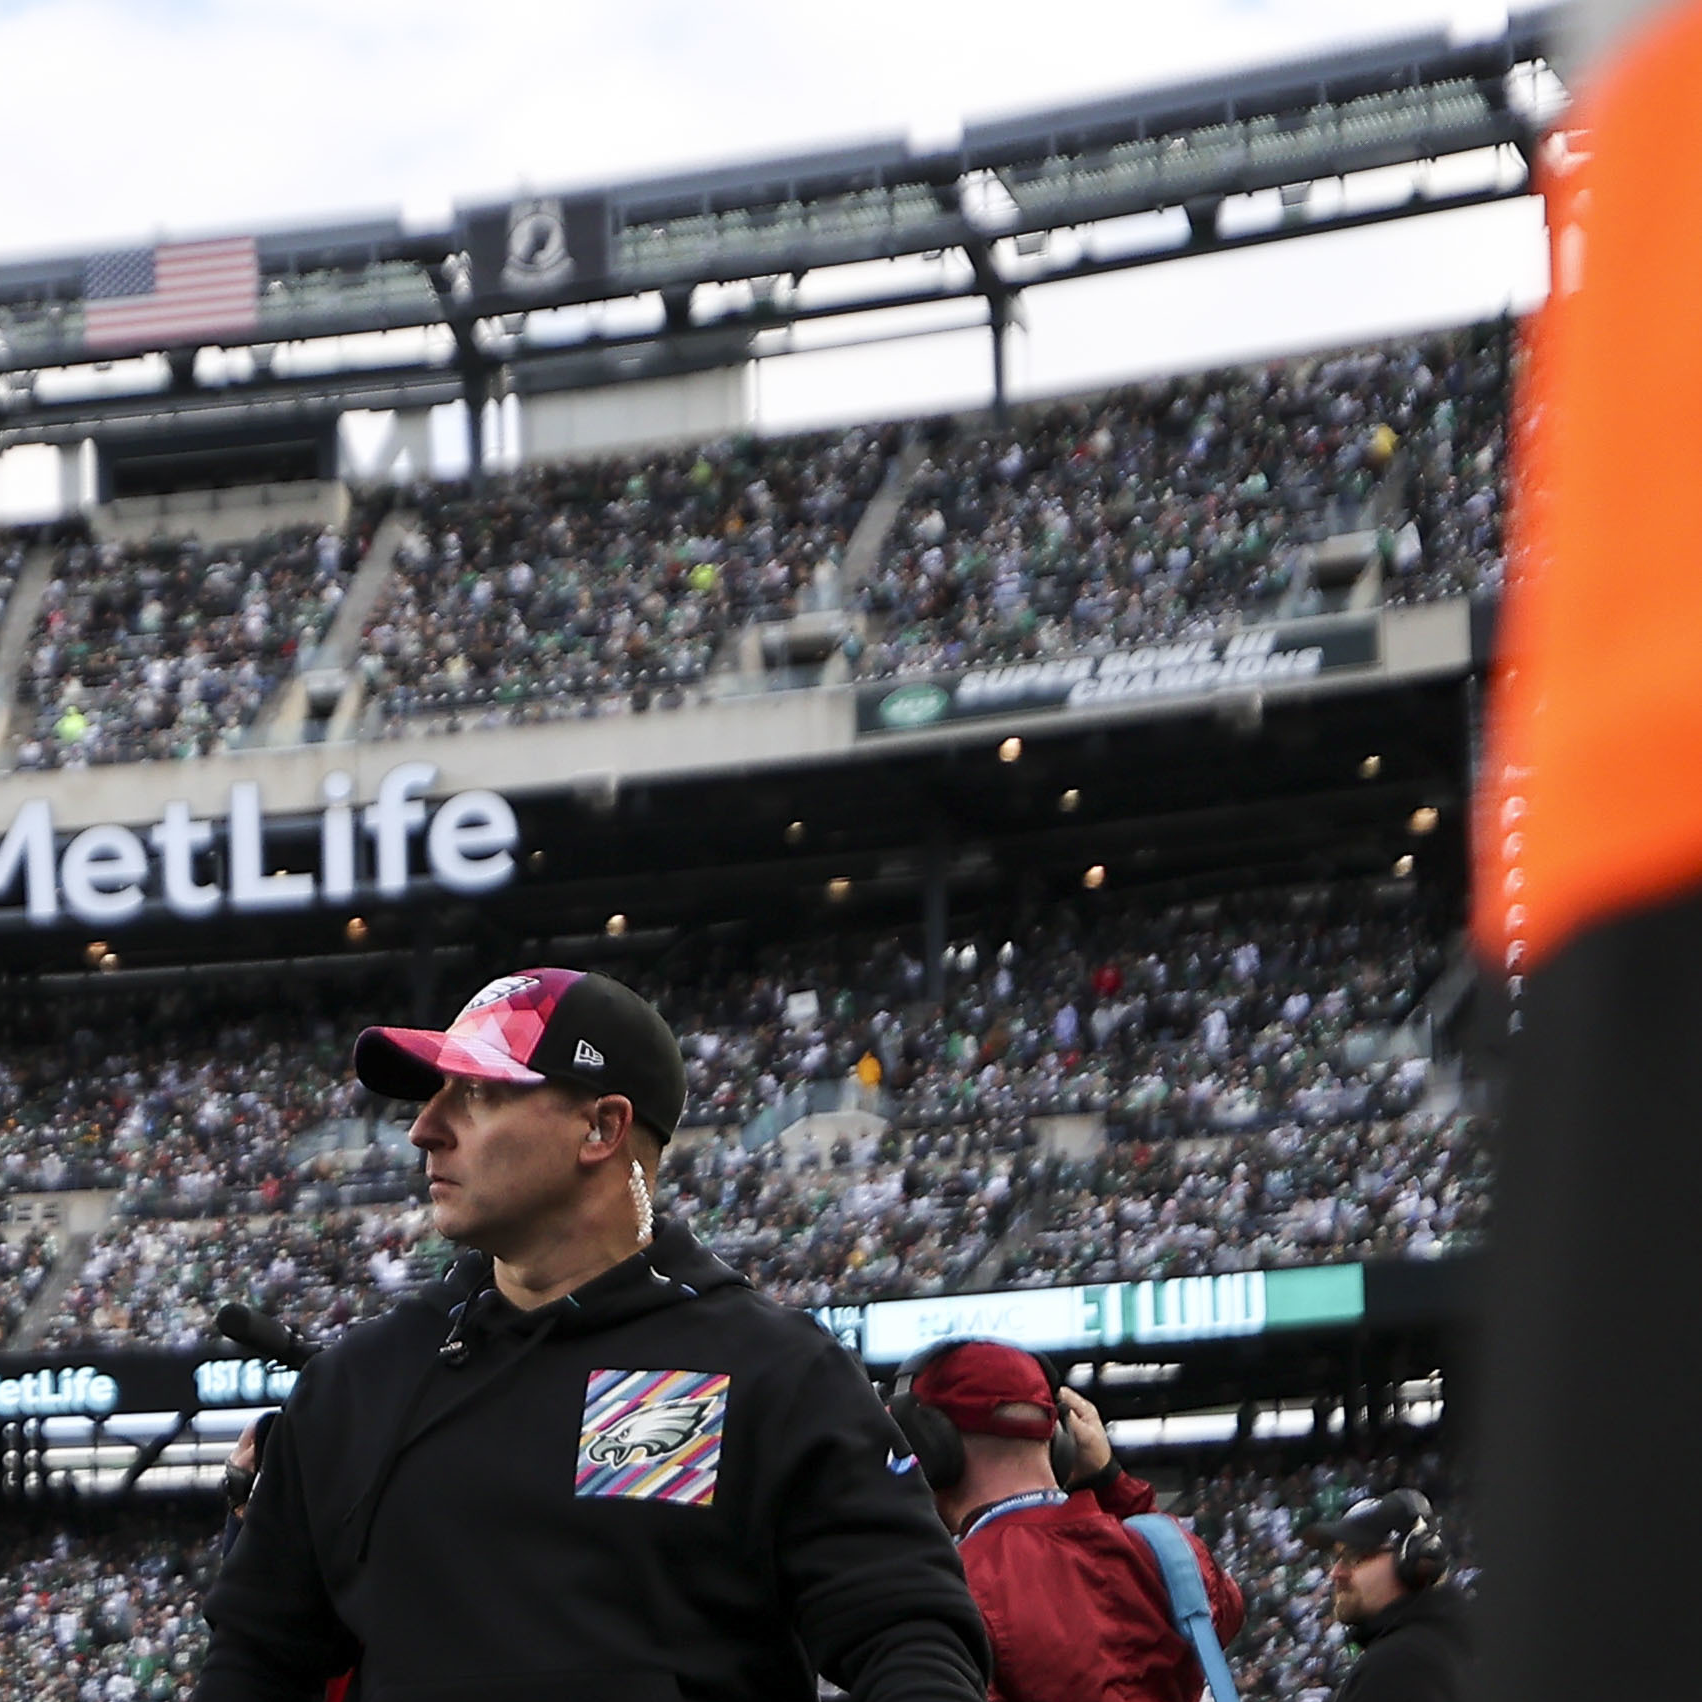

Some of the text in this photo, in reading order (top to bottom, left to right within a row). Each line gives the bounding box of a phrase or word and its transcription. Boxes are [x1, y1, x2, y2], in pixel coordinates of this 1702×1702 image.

[957, 656, 1094, 703] SUPER
[1097, 638, 1216, 676] BOWL
[1069, 646, 1322, 704] CHAMPIONS
